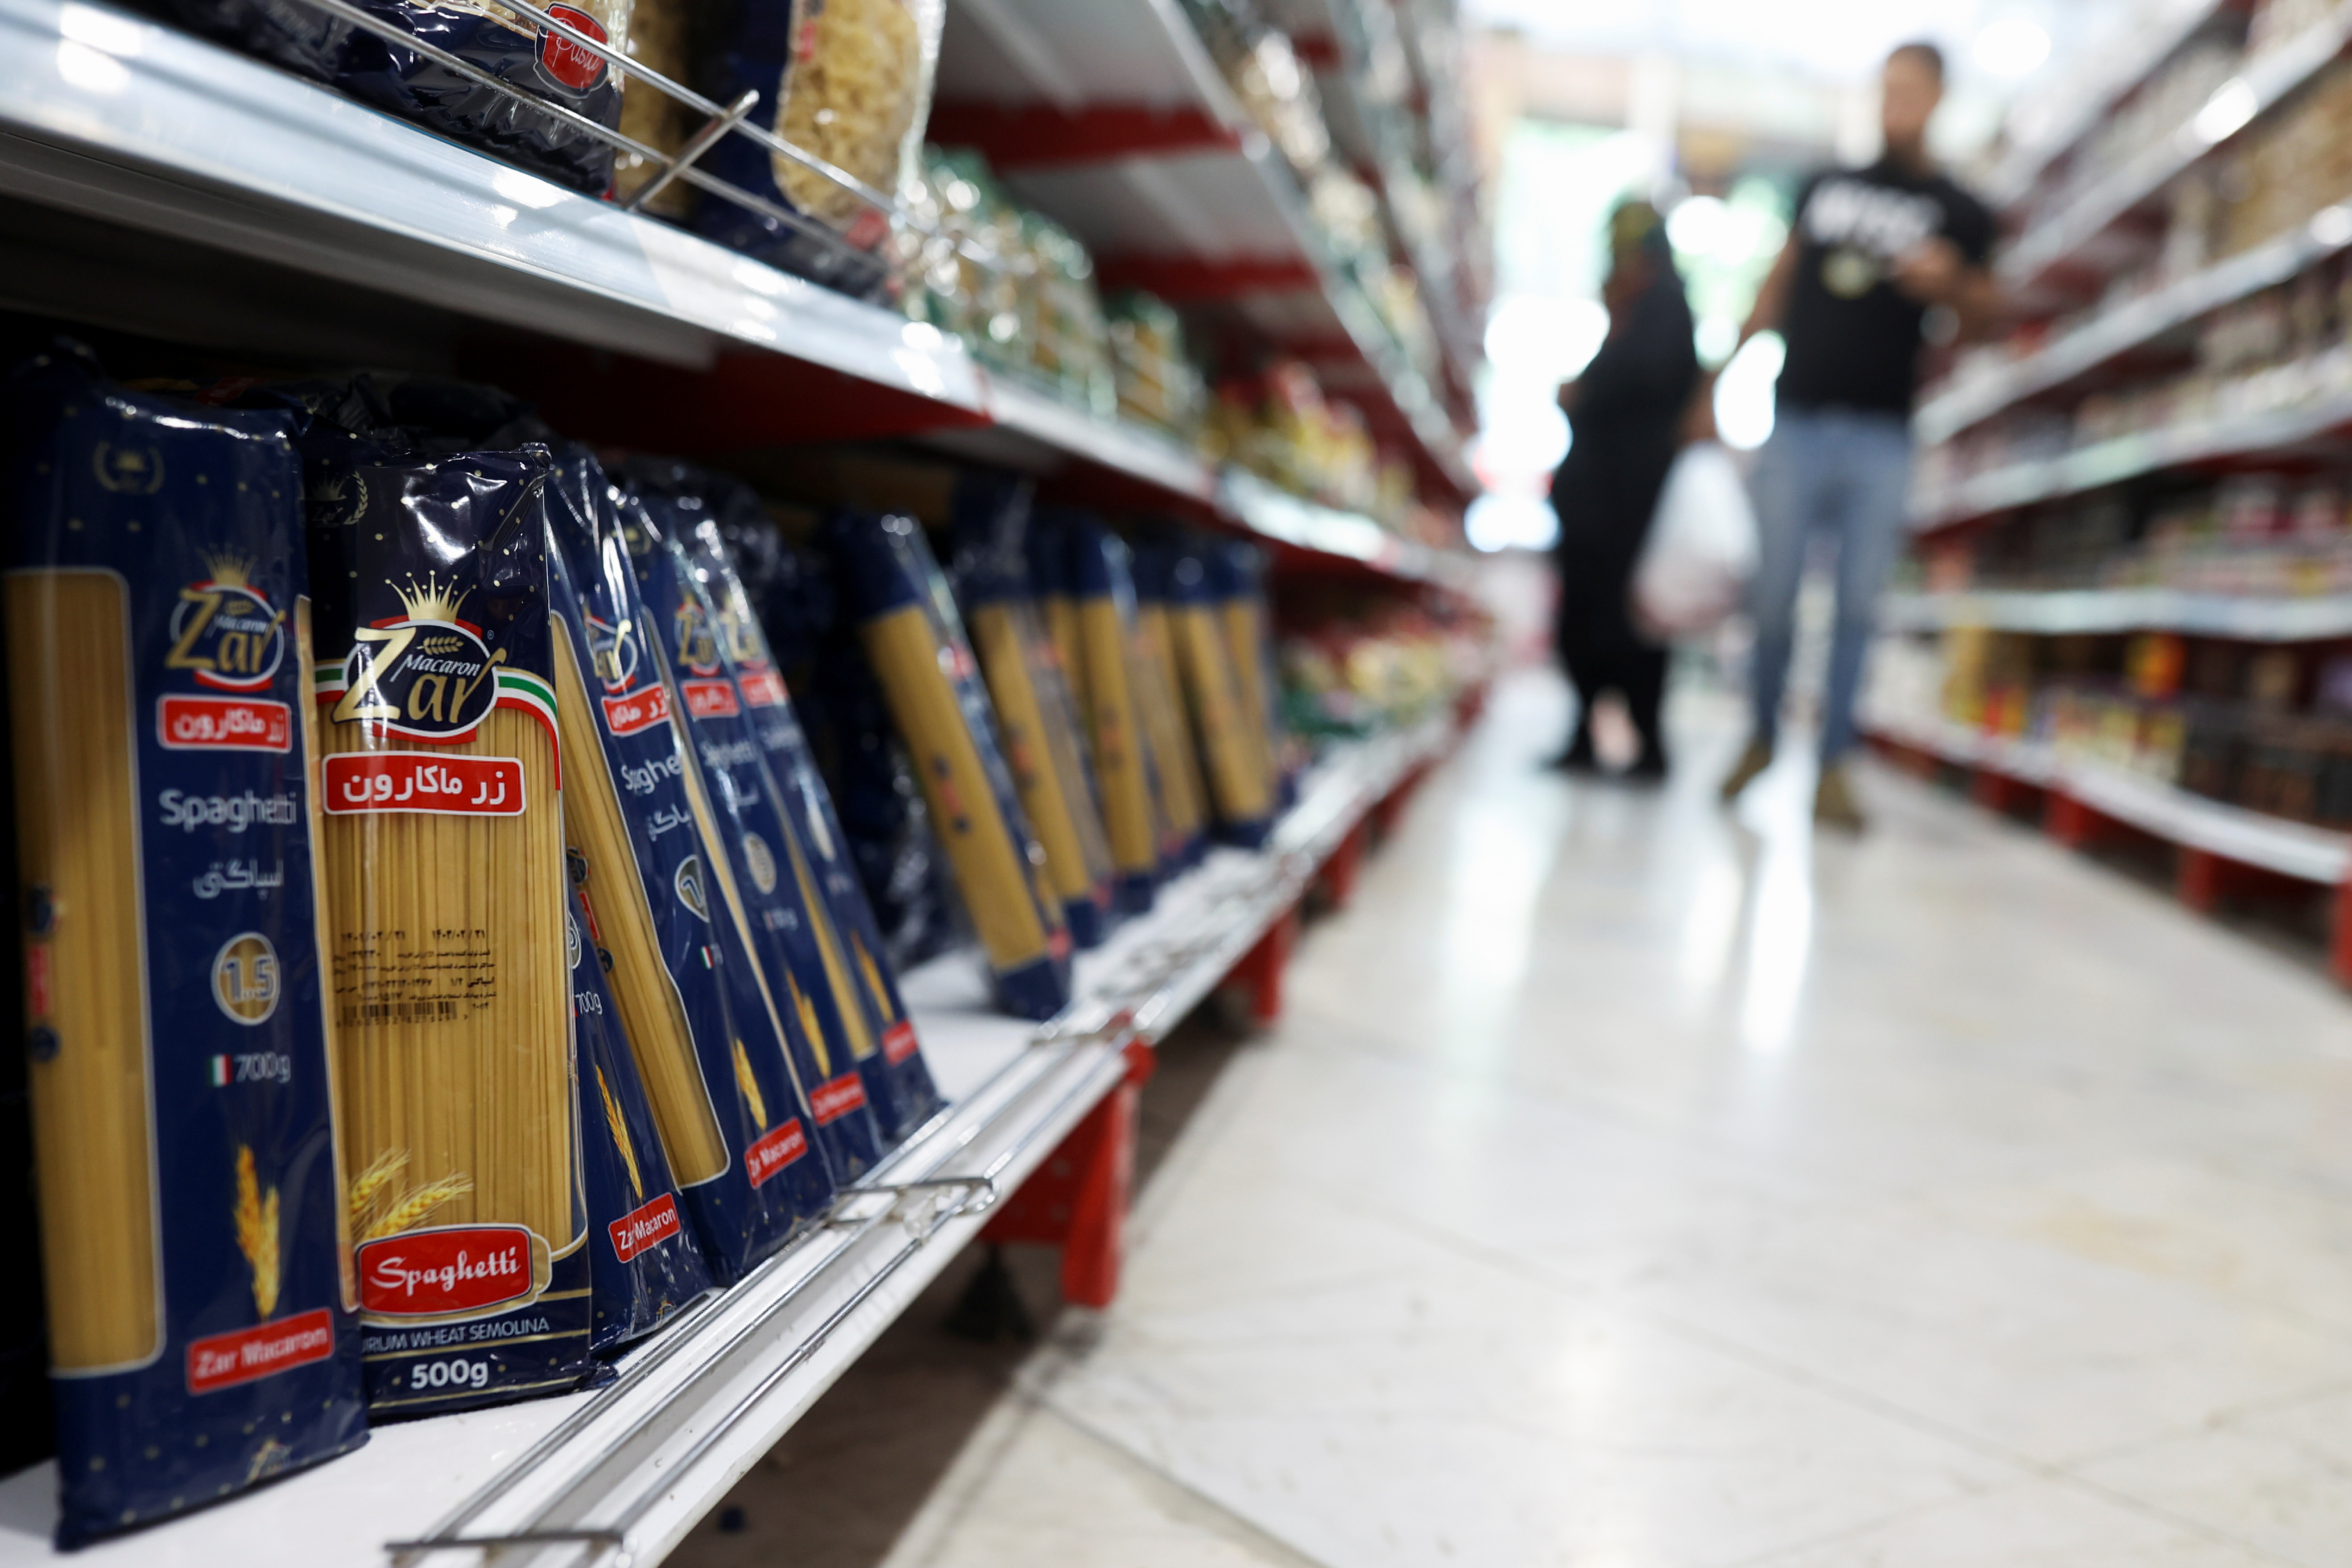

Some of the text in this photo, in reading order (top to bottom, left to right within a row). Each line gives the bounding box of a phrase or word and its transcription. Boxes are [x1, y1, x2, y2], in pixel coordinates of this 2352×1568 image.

[165, 588, 286, 673] Zar
[332, 627, 507, 724] Zar
[389, 654, 481, 682] Macaron
[343, 765, 506, 805] زر ماکارون
[158, 788, 297, 833] Spaghetti
[234, 1051, 290, 1084] 700g
[369, 1247, 521, 1296] Spaghetti
[241, 1327, 328, 1368] Macaron
[362, 1316, 550, 1353] RUM WHEAT SEMOLINA
[410, 1358, 488, 1390] 500g
